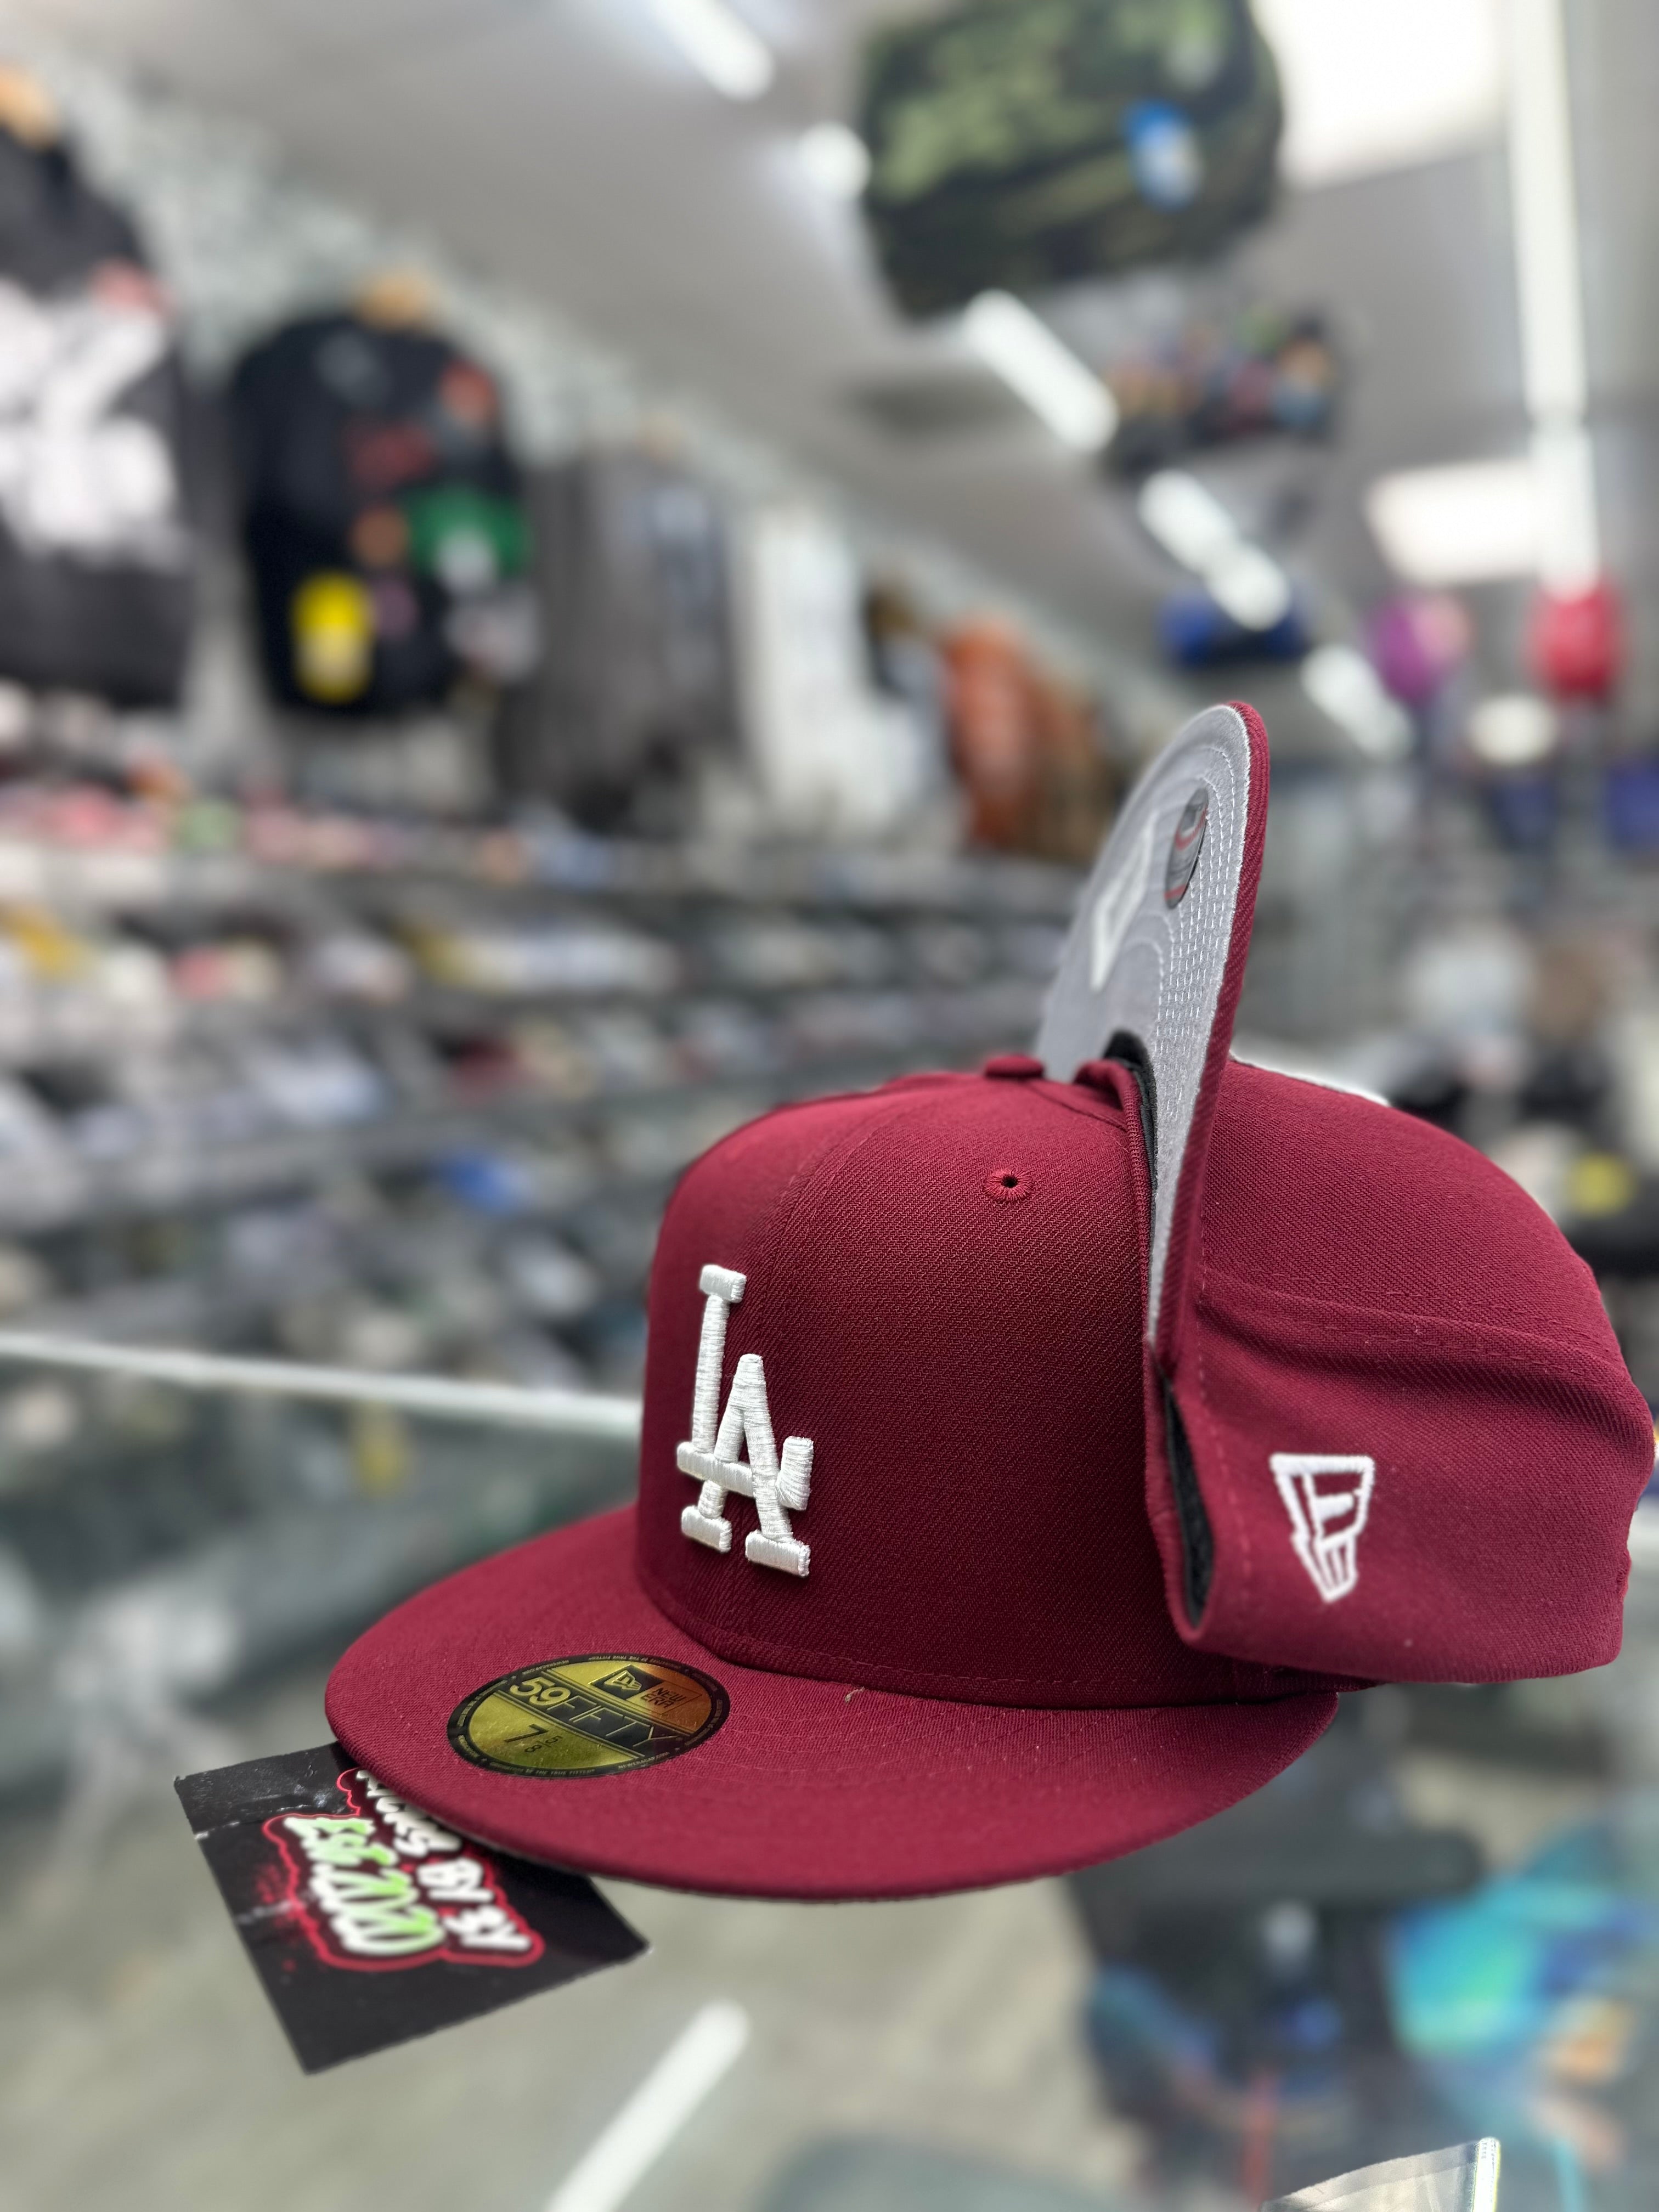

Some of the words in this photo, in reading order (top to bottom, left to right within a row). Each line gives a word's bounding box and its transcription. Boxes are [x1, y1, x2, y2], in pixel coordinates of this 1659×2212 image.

[677, 1264, 814, 1577] LA
[639, 1694, 675, 1708] ERA
[654, 1687, 688, 1702] NEW
[509, 1676, 681, 1747] 59FIFTY
[504, 1724, 549, 1743] 7
[416, 1857, 494, 1903] BY
